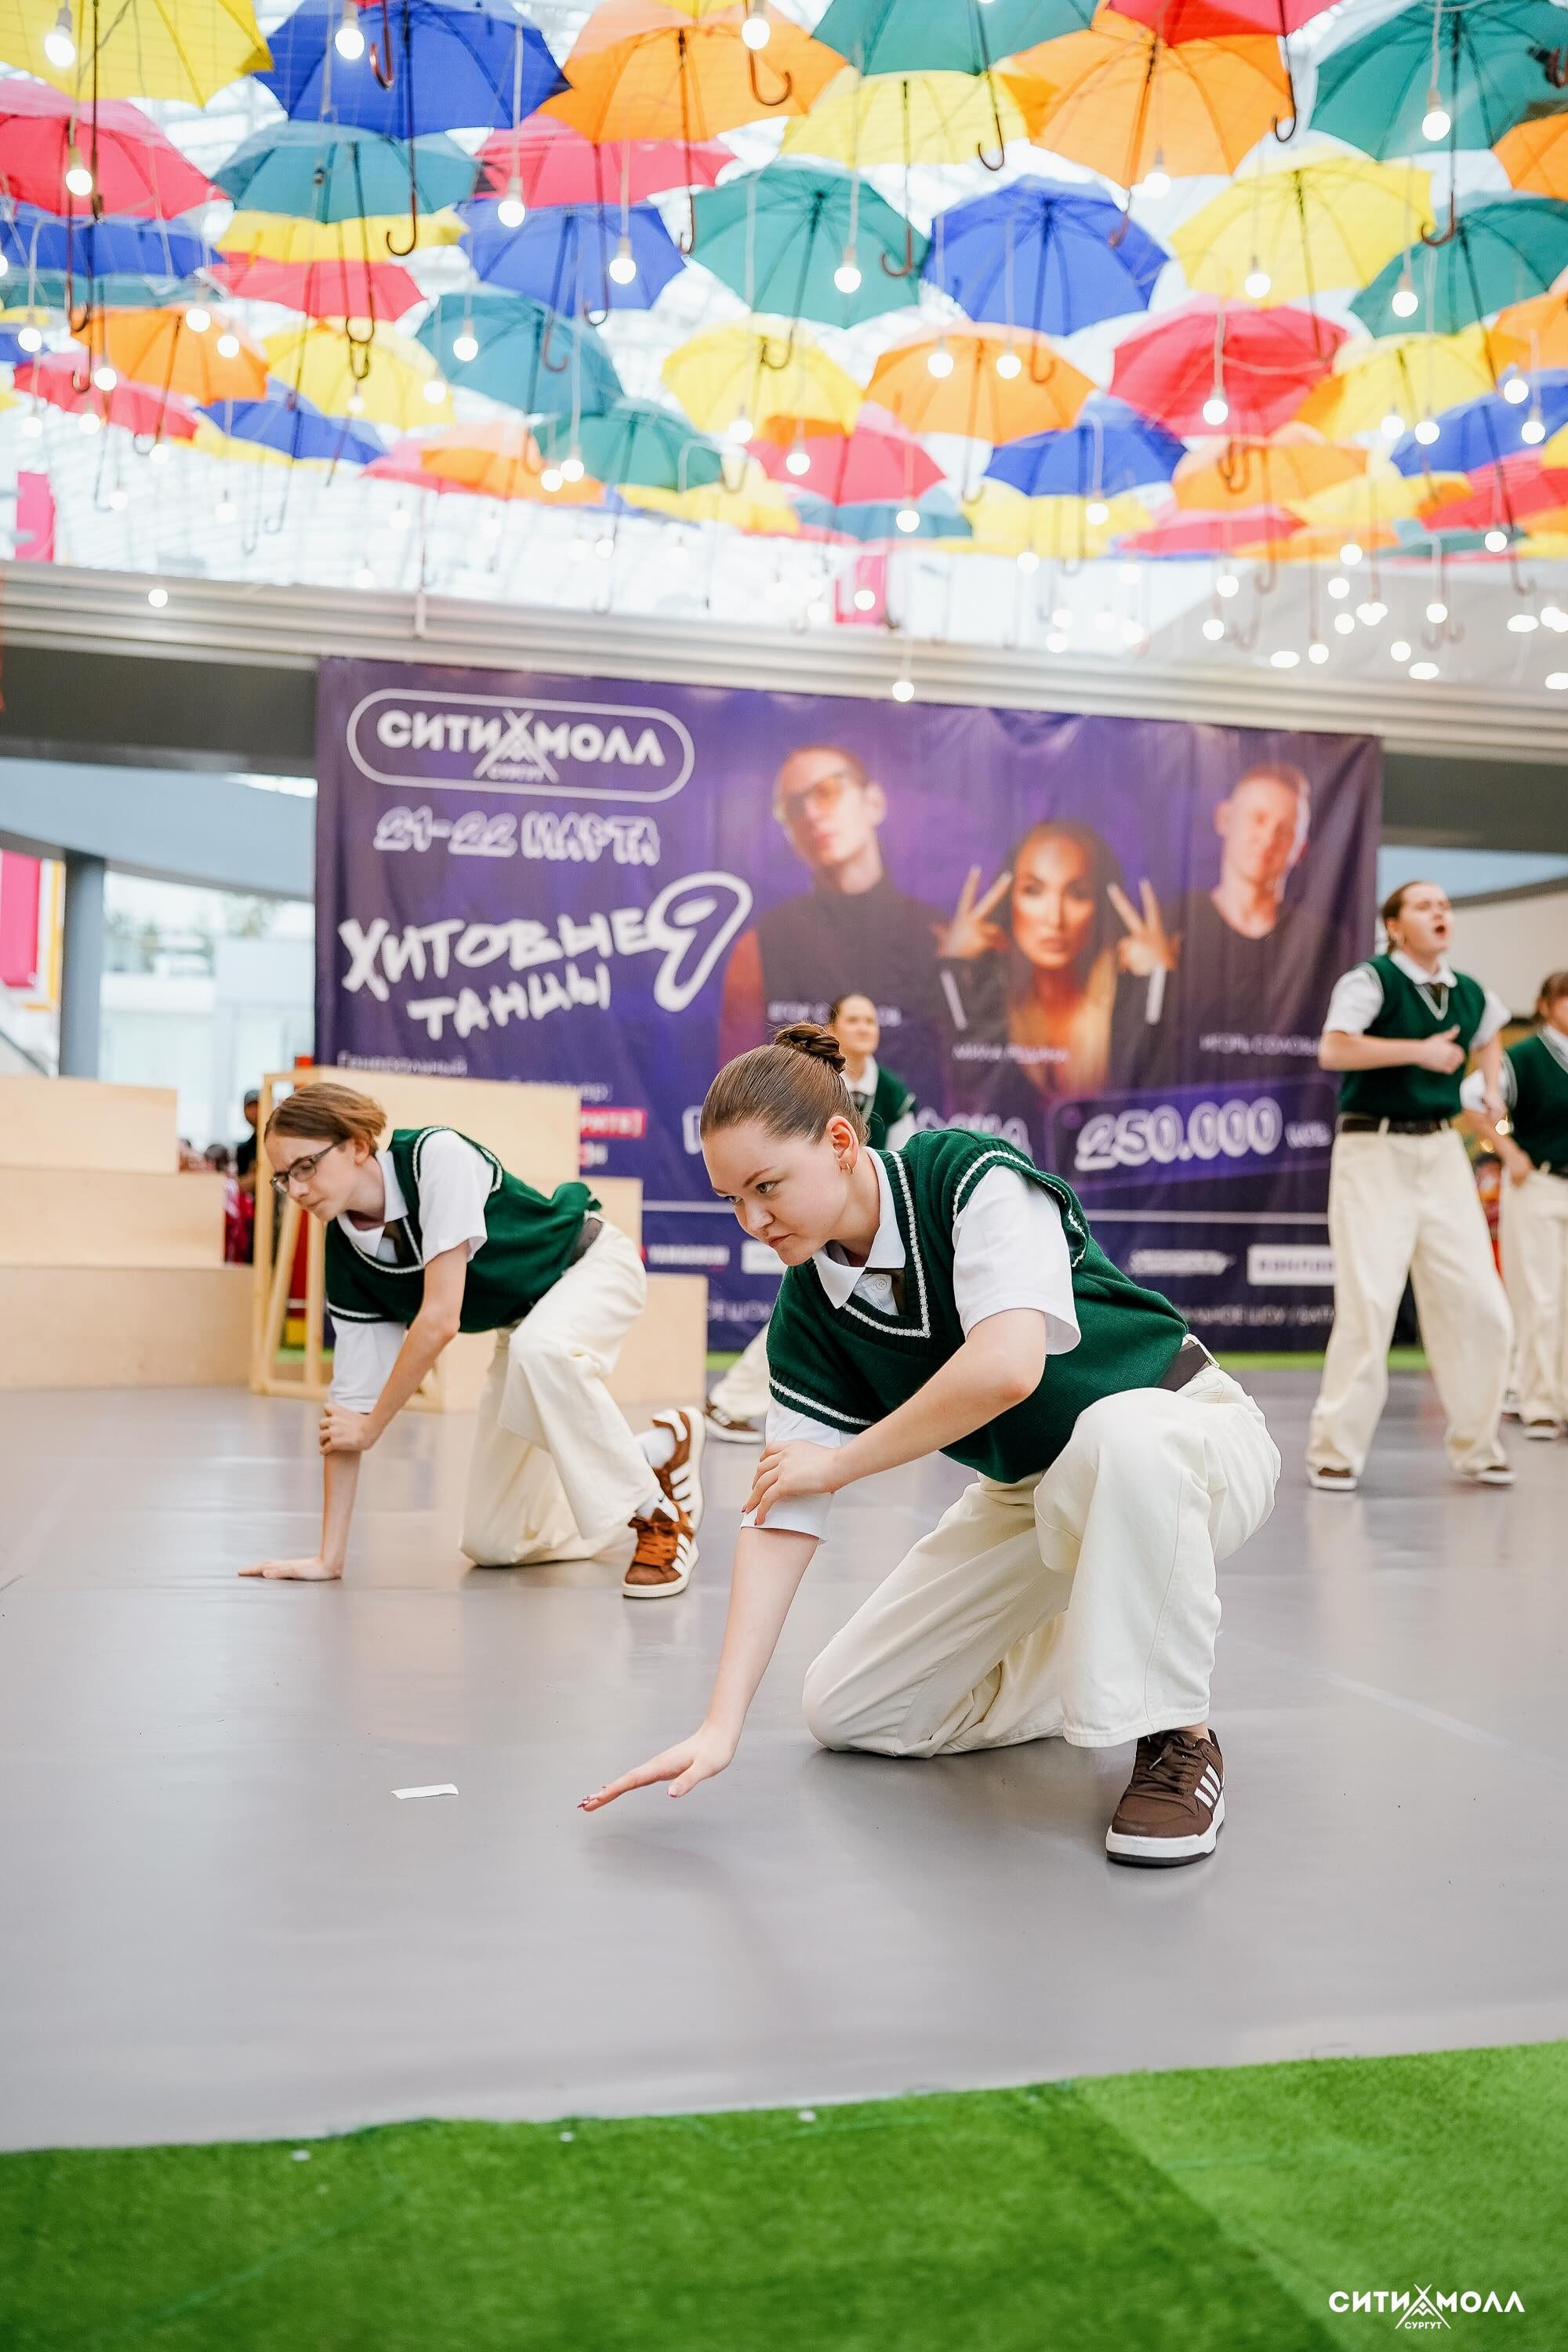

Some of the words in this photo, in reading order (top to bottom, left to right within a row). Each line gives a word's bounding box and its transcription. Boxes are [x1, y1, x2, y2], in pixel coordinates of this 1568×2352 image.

[376, 709, 502, 753] СИТИ
[533, 720, 666, 766] МОЛЛ
[1075, 1097, 1283, 1170] 250.000
